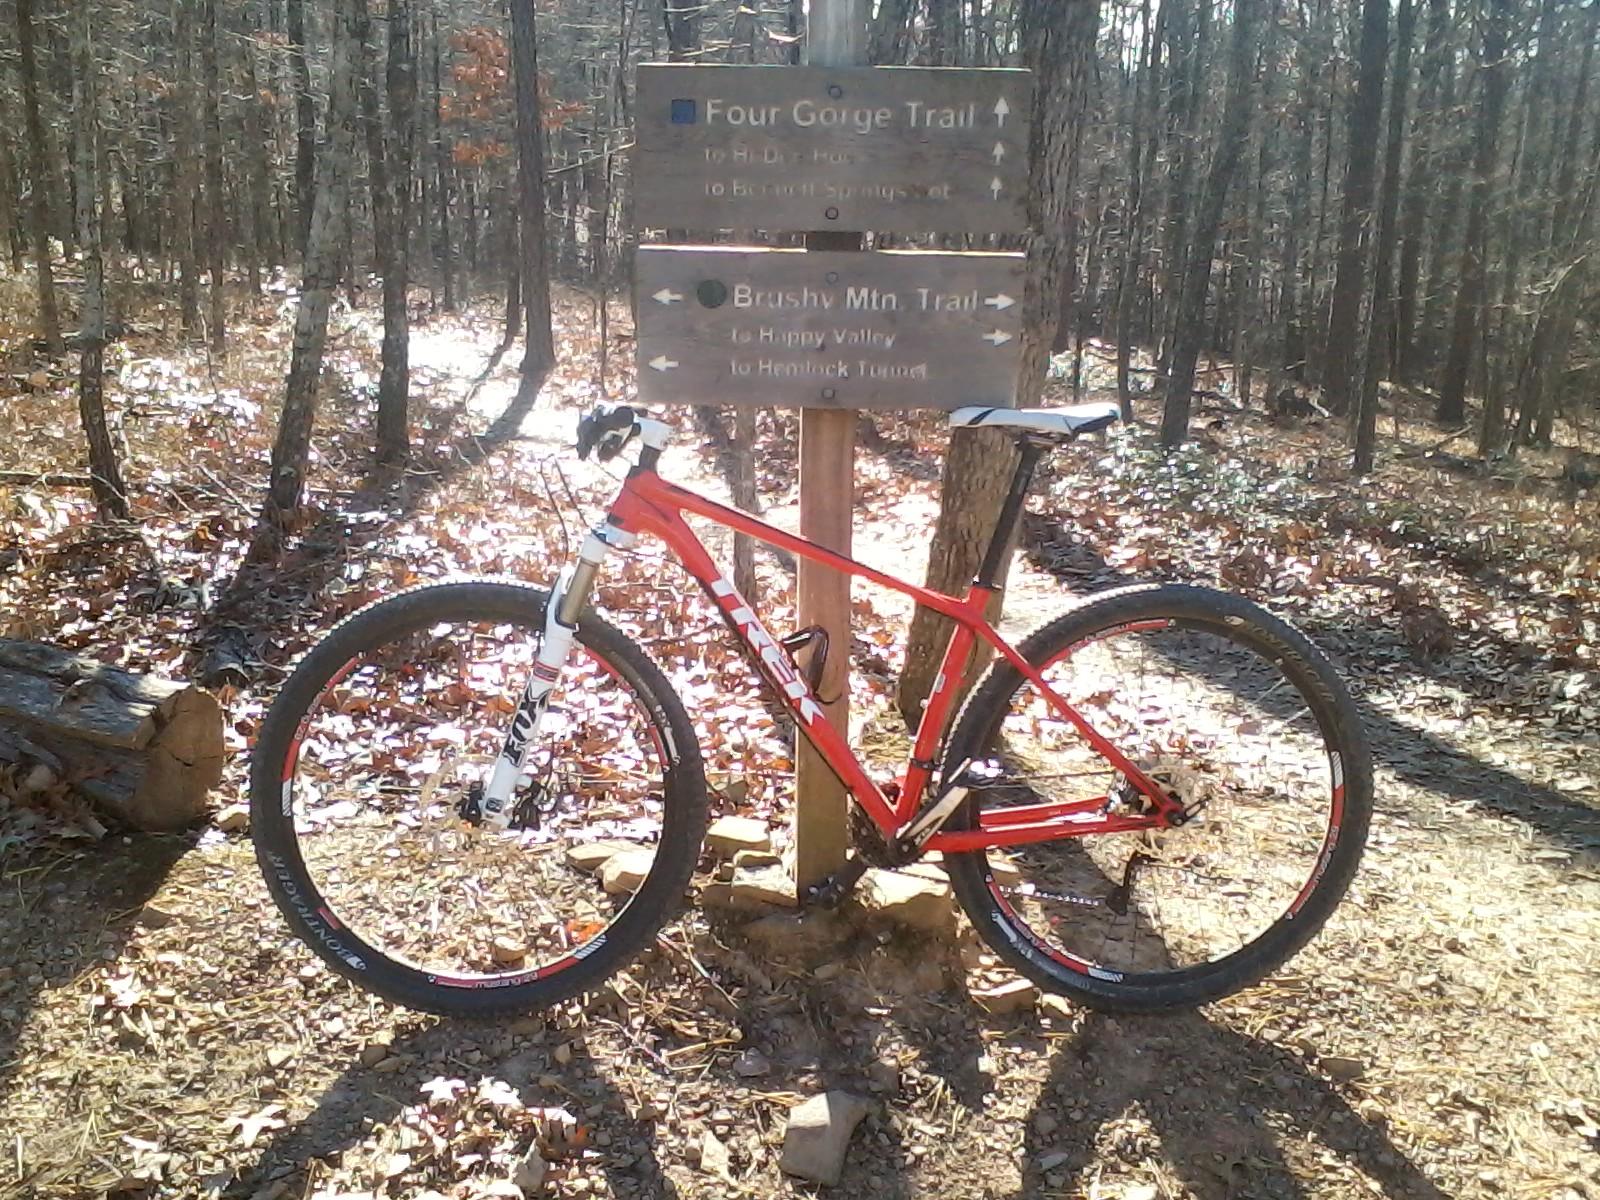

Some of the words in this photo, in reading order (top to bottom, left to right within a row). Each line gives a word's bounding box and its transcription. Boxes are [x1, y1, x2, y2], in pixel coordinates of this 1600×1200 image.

[705, 99, 781, 126] Four
[792, 100, 893, 135] Gorge
[905, 101, 976, 128] Trail
[732, 285, 834, 310] Brushy
[917, 287, 979, 312] Trail
[731, 327, 752, 344] to
[832, 328, 897, 349] Valley
[730, 359, 752, 376] to
[710, 577, 826, 727] TREK
[502, 681, 552, 768] FOX
[267, 853, 353, 965] BONTRAGER
